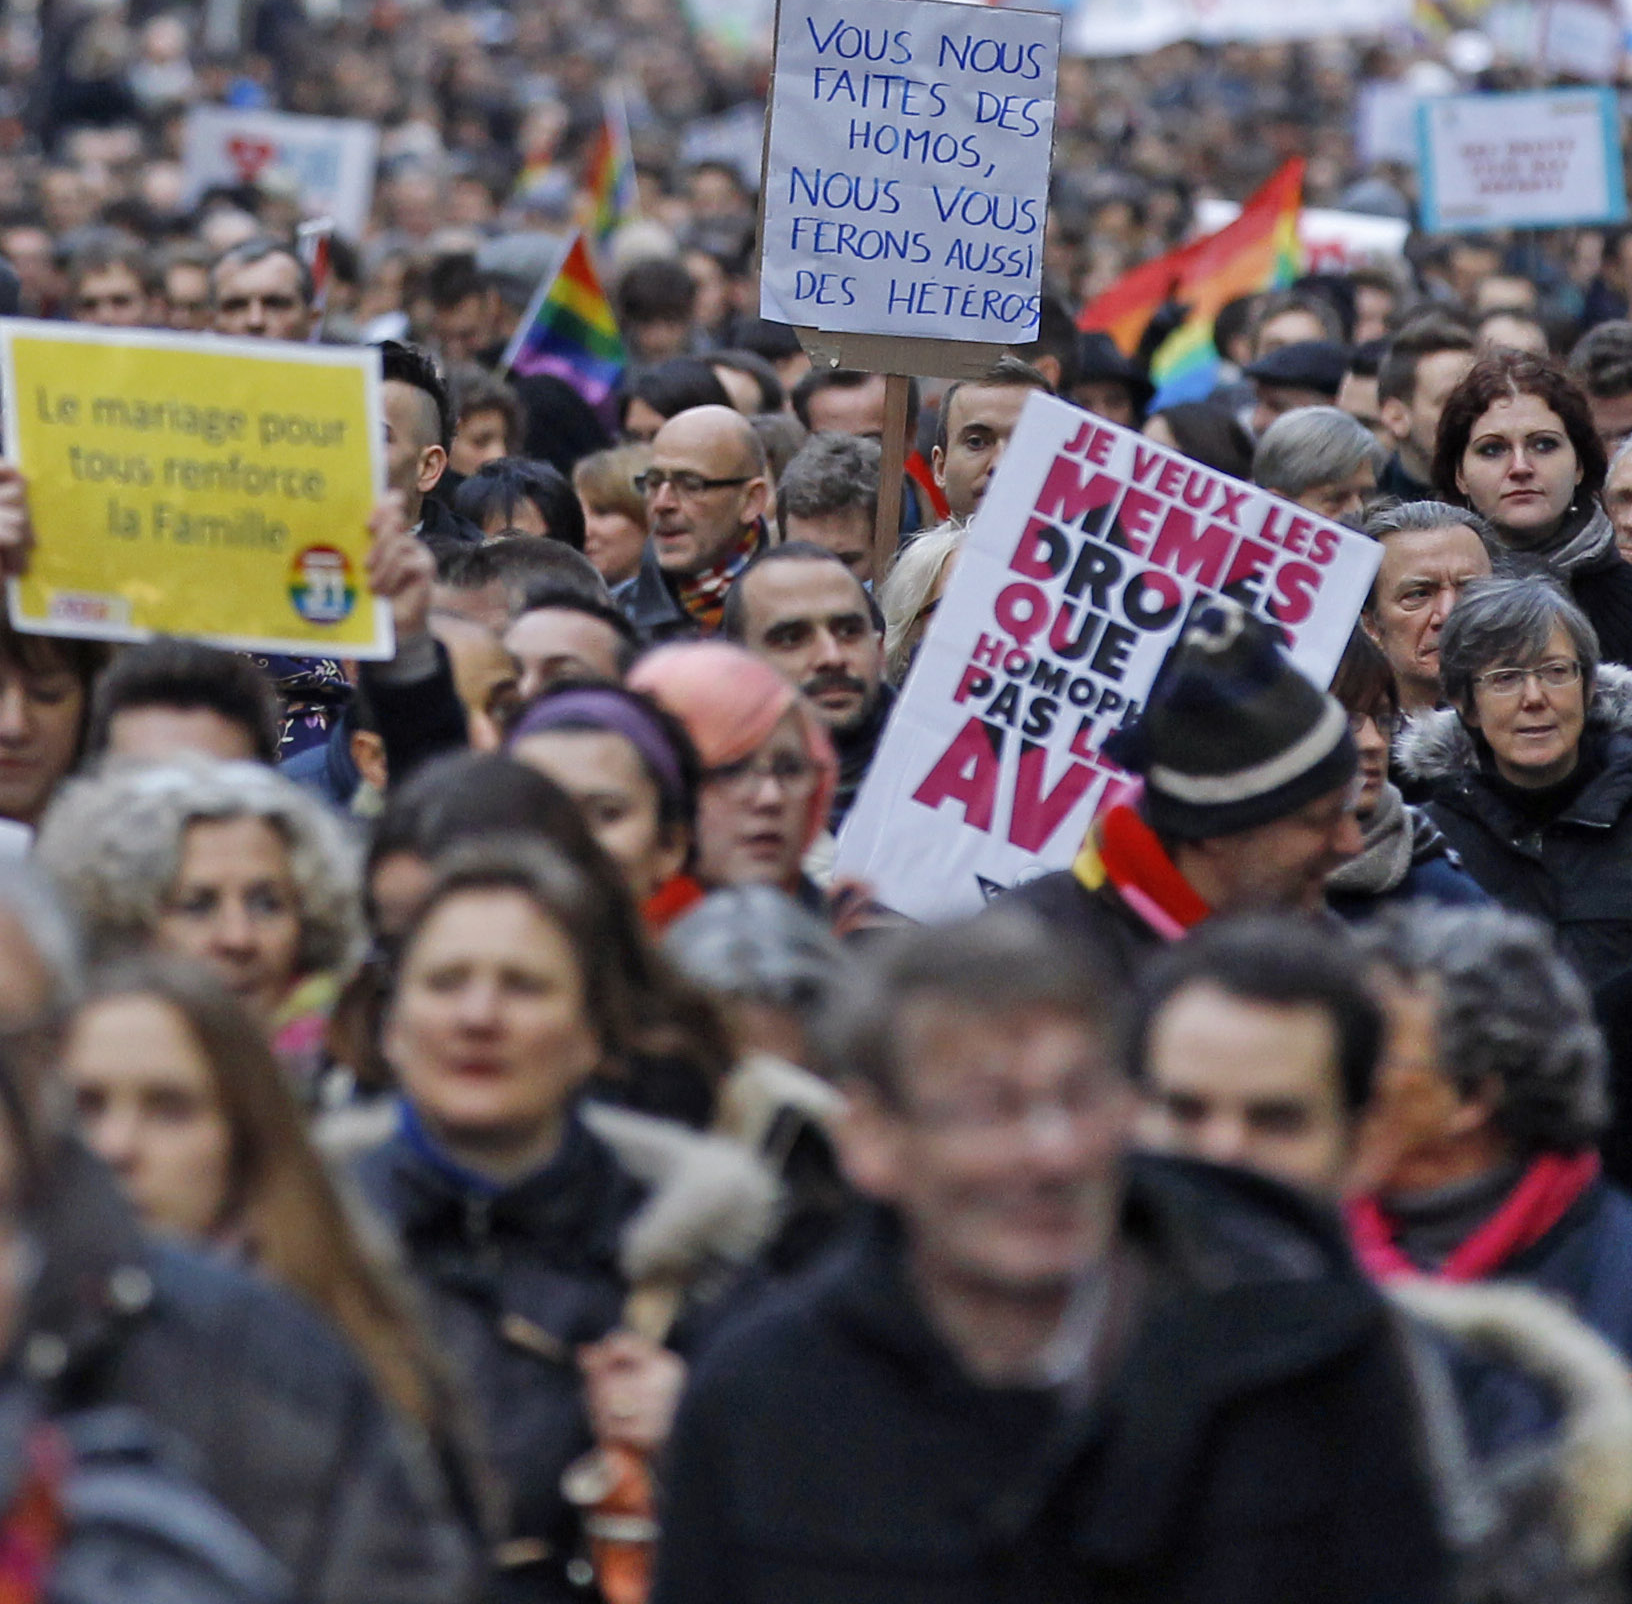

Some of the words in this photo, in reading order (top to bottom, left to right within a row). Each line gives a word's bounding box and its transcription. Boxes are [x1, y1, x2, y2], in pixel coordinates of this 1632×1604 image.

[807, 16, 913, 65] VOUS
[938, 33, 1048, 80] NOUS
[813, 67, 950, 117] FAITES
[976, 90, 1040, 137] DES
[849, 118, 997, 178] HOMOS,
[788, 166, 901, 213] NOUS
[933, 185, 1037, 235] VOUS
[791, 217, 931, 264] FERONS
[944, 238, 1034, 279] AUSSI
[795, 270, 856, 306] DES
[888, 276, 1041, 330] HÉTÉROS
[36, 385, 78, 425] Le
[92, 396, 246, 443] mariage
[259, 414, 348, 448] pour
[69, 444, 153, 483] tous
[164, 454, 325, 501] renforce
[1063, 421, 1118, 466] JE
[1133, 444, 1254, 527] VEUX
[1260, 505, 1341, 565] LES
[107, 501, 141, 538] la
[152, 503, 291, 553] Famille
[1034, 456, 1323, 625] MEMES
[995, 580, 1141, 681] QUE
[954, 665, 1059, 737] PAS
